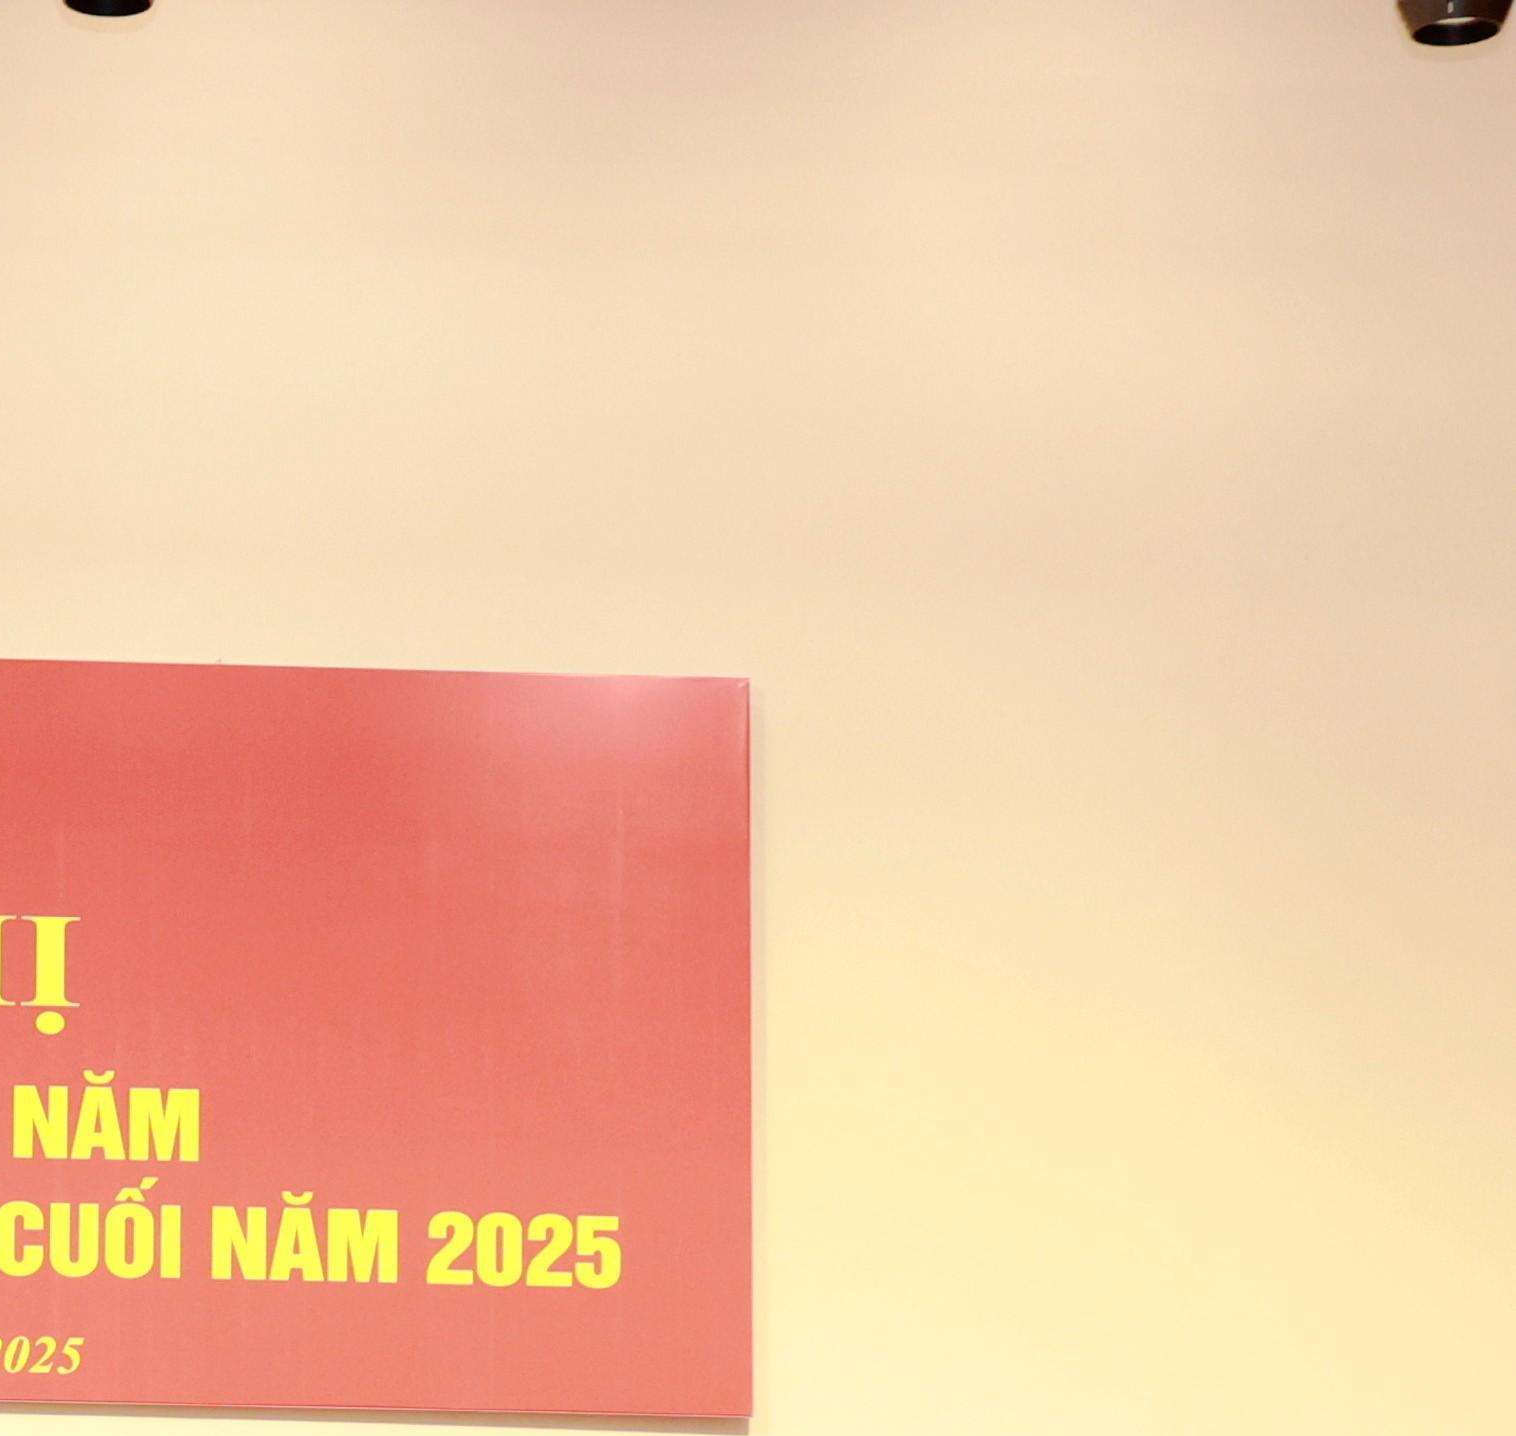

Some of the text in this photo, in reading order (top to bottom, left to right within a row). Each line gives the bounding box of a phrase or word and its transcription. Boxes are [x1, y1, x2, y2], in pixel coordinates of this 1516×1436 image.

[12, 1069, 200, 1163] NĂM
[210, 1190, 401, 1284] NĂM
[425, 1210, 622, 1290] 2025
